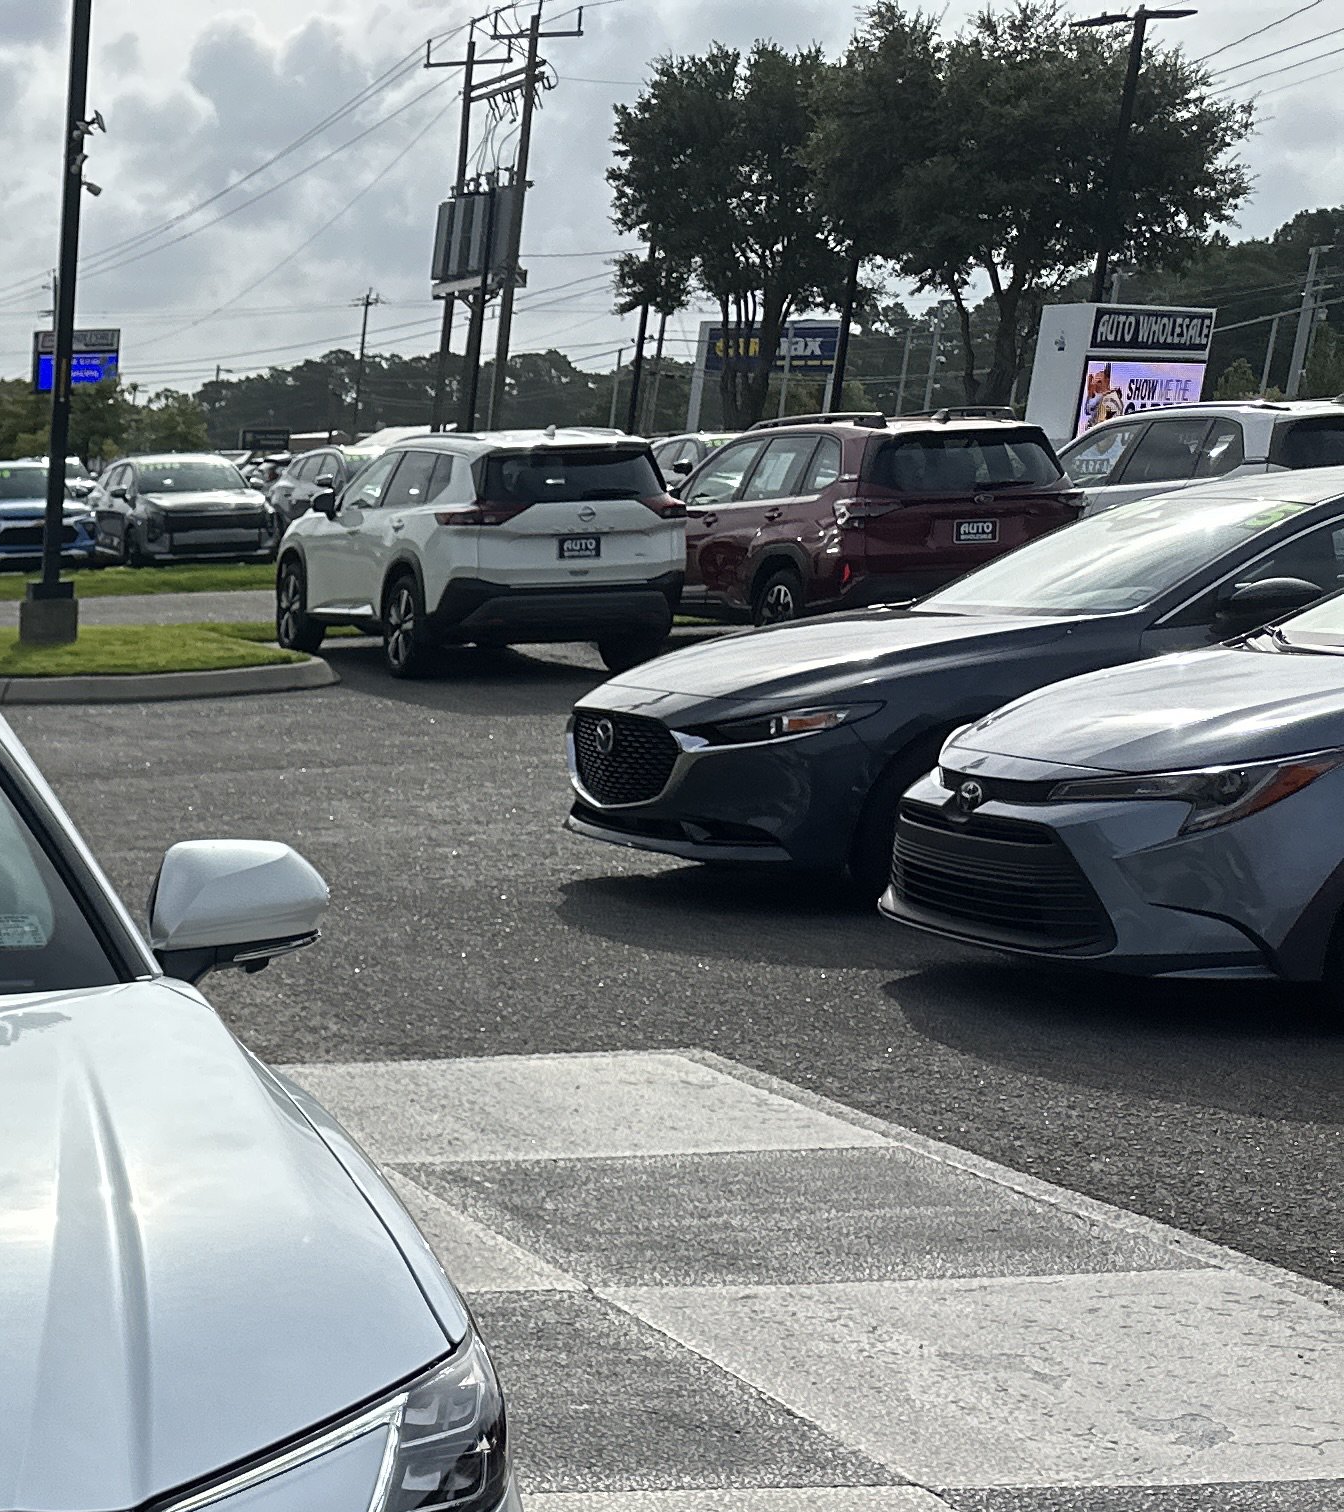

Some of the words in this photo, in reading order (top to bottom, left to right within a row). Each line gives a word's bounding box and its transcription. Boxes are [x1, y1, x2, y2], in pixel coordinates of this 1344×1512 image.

[1096, 314, 1135, 343] AUTO
[1137, 315, 1211, 345] WHOLESALE
[1127, 378, 1158, 401] SHOW
[960, 522, 992, 535] AUTO
[563, 539, 596, 550] AUTO
